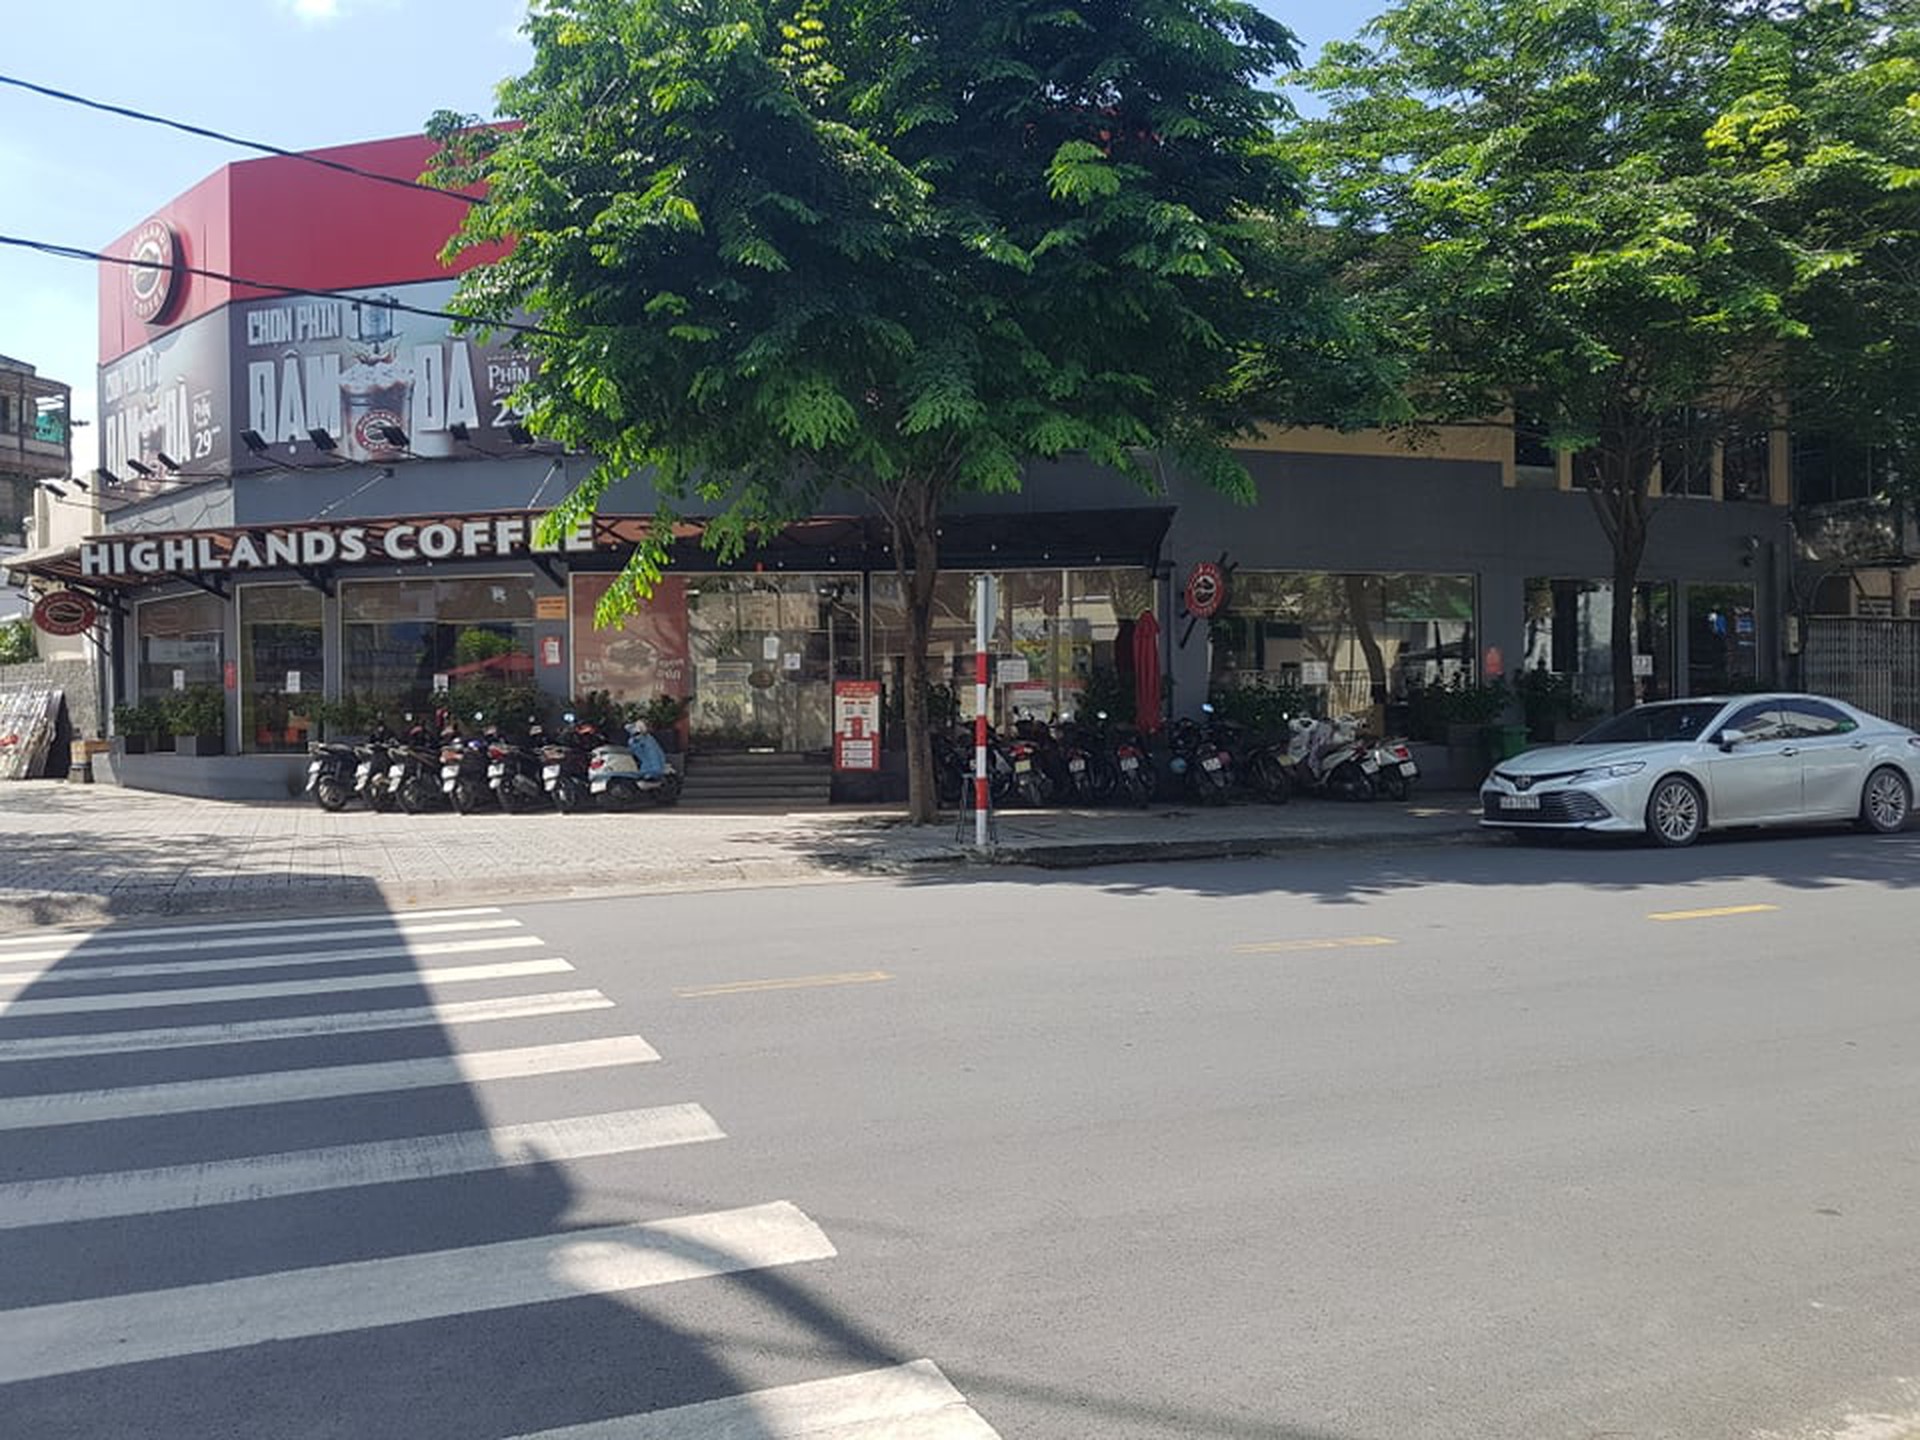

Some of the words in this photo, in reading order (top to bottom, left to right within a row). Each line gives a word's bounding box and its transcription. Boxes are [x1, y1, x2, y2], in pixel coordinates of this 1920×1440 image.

[247, 306, 292, 347] CHỌN
[296, 303, 340, 341] PHIN
[195, 430, 212, 459] 29
[79, 526, 368, 576] HIGHLANDS
